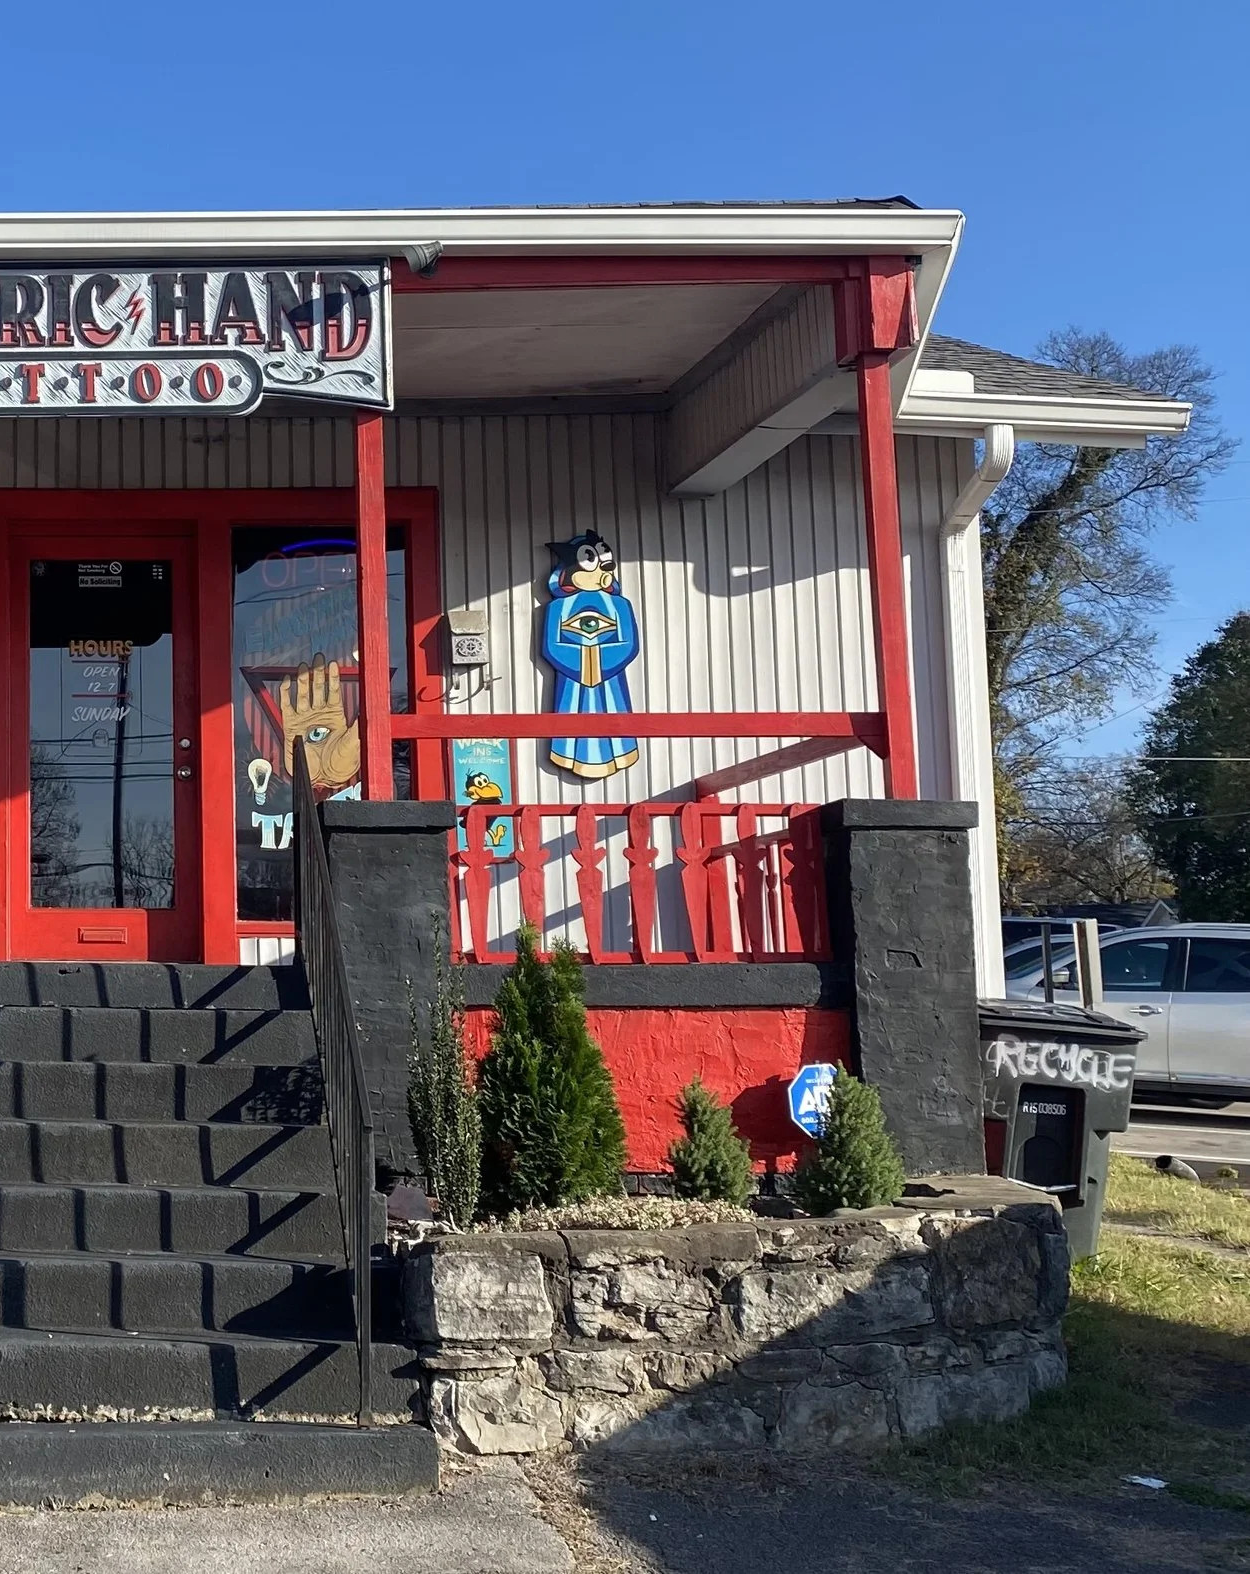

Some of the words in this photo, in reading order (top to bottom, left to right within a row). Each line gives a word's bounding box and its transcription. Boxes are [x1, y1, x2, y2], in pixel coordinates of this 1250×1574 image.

[148, 271, 373, 362] HAND
[79, 577, 89, 586] No
[90, 577, 121, 587] Soliciting
[69, 639, 134, 657] HOURS
[83, 665, 120, 678] OPEN
[71, 705, 131, 722] SUNDAY
[457, 757, 507, 765] WELCOME
[986, 1033, 1137, 1091] RECYCLE
